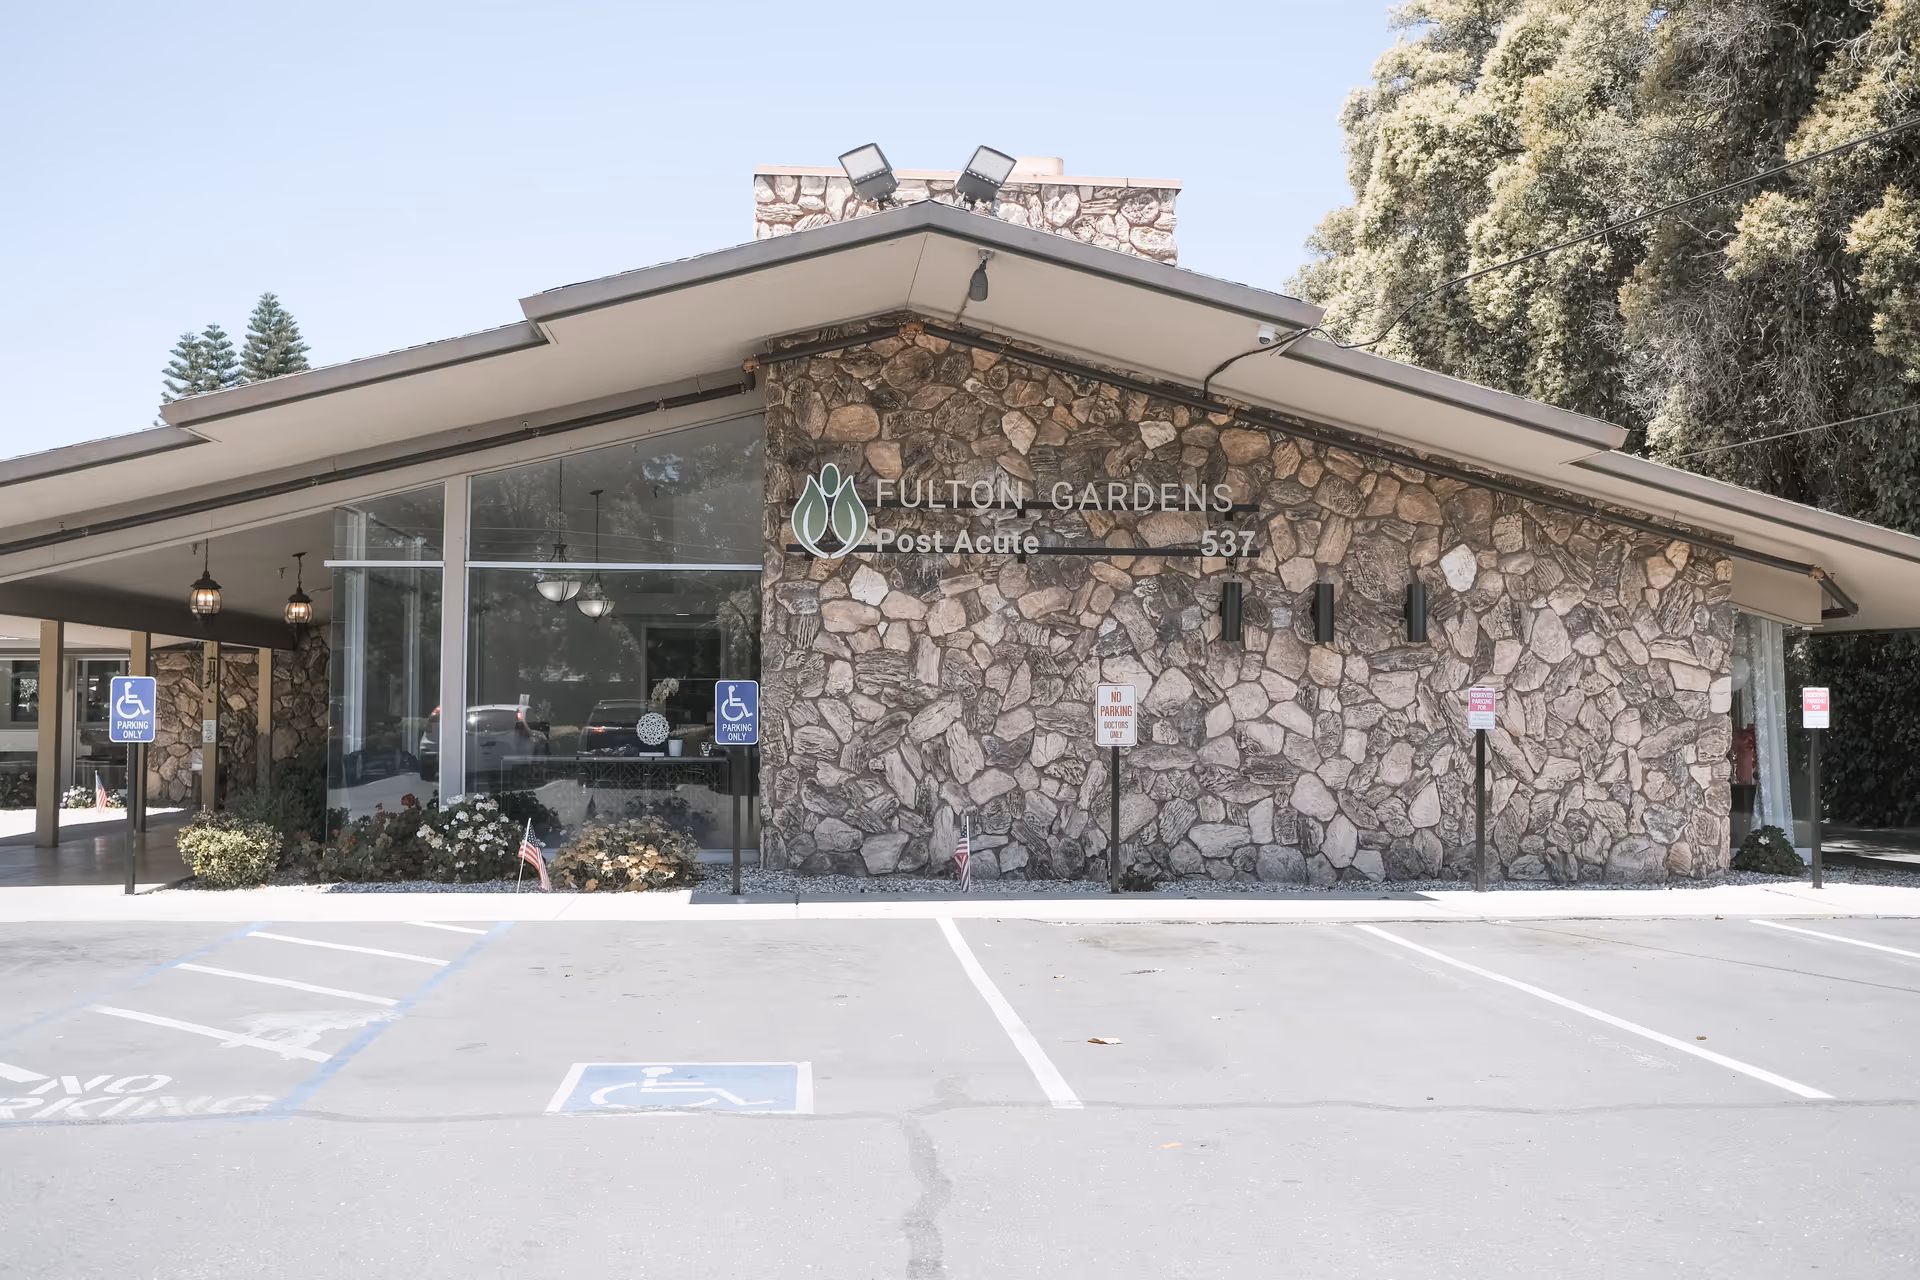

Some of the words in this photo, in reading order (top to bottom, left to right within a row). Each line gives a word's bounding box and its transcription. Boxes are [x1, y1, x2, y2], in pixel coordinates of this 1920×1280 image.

[876, 479, 1023, 509] FULTON
[1051, 481, 1233, 512] GARDENS
[876, 528, 943, 553] Post
[953, 529, 1039, 554] Acute
[1201, 530, 1256, 557] 537
[1111, 691, 1122, 703] NO
[1100, 705, 1133, 717] PARKING
[117, 720, 149, 730] PARKING
[722, 723, 753, 732] PARKING
[1103, 720, 1129, 729] DOCTORS
[123, 730, 143, 739] ONLY
[728, 732, 747, 741] ONLY
[1109, 730, 1123, 739] ONLY
[27, 1074, 173, 1094] NO
